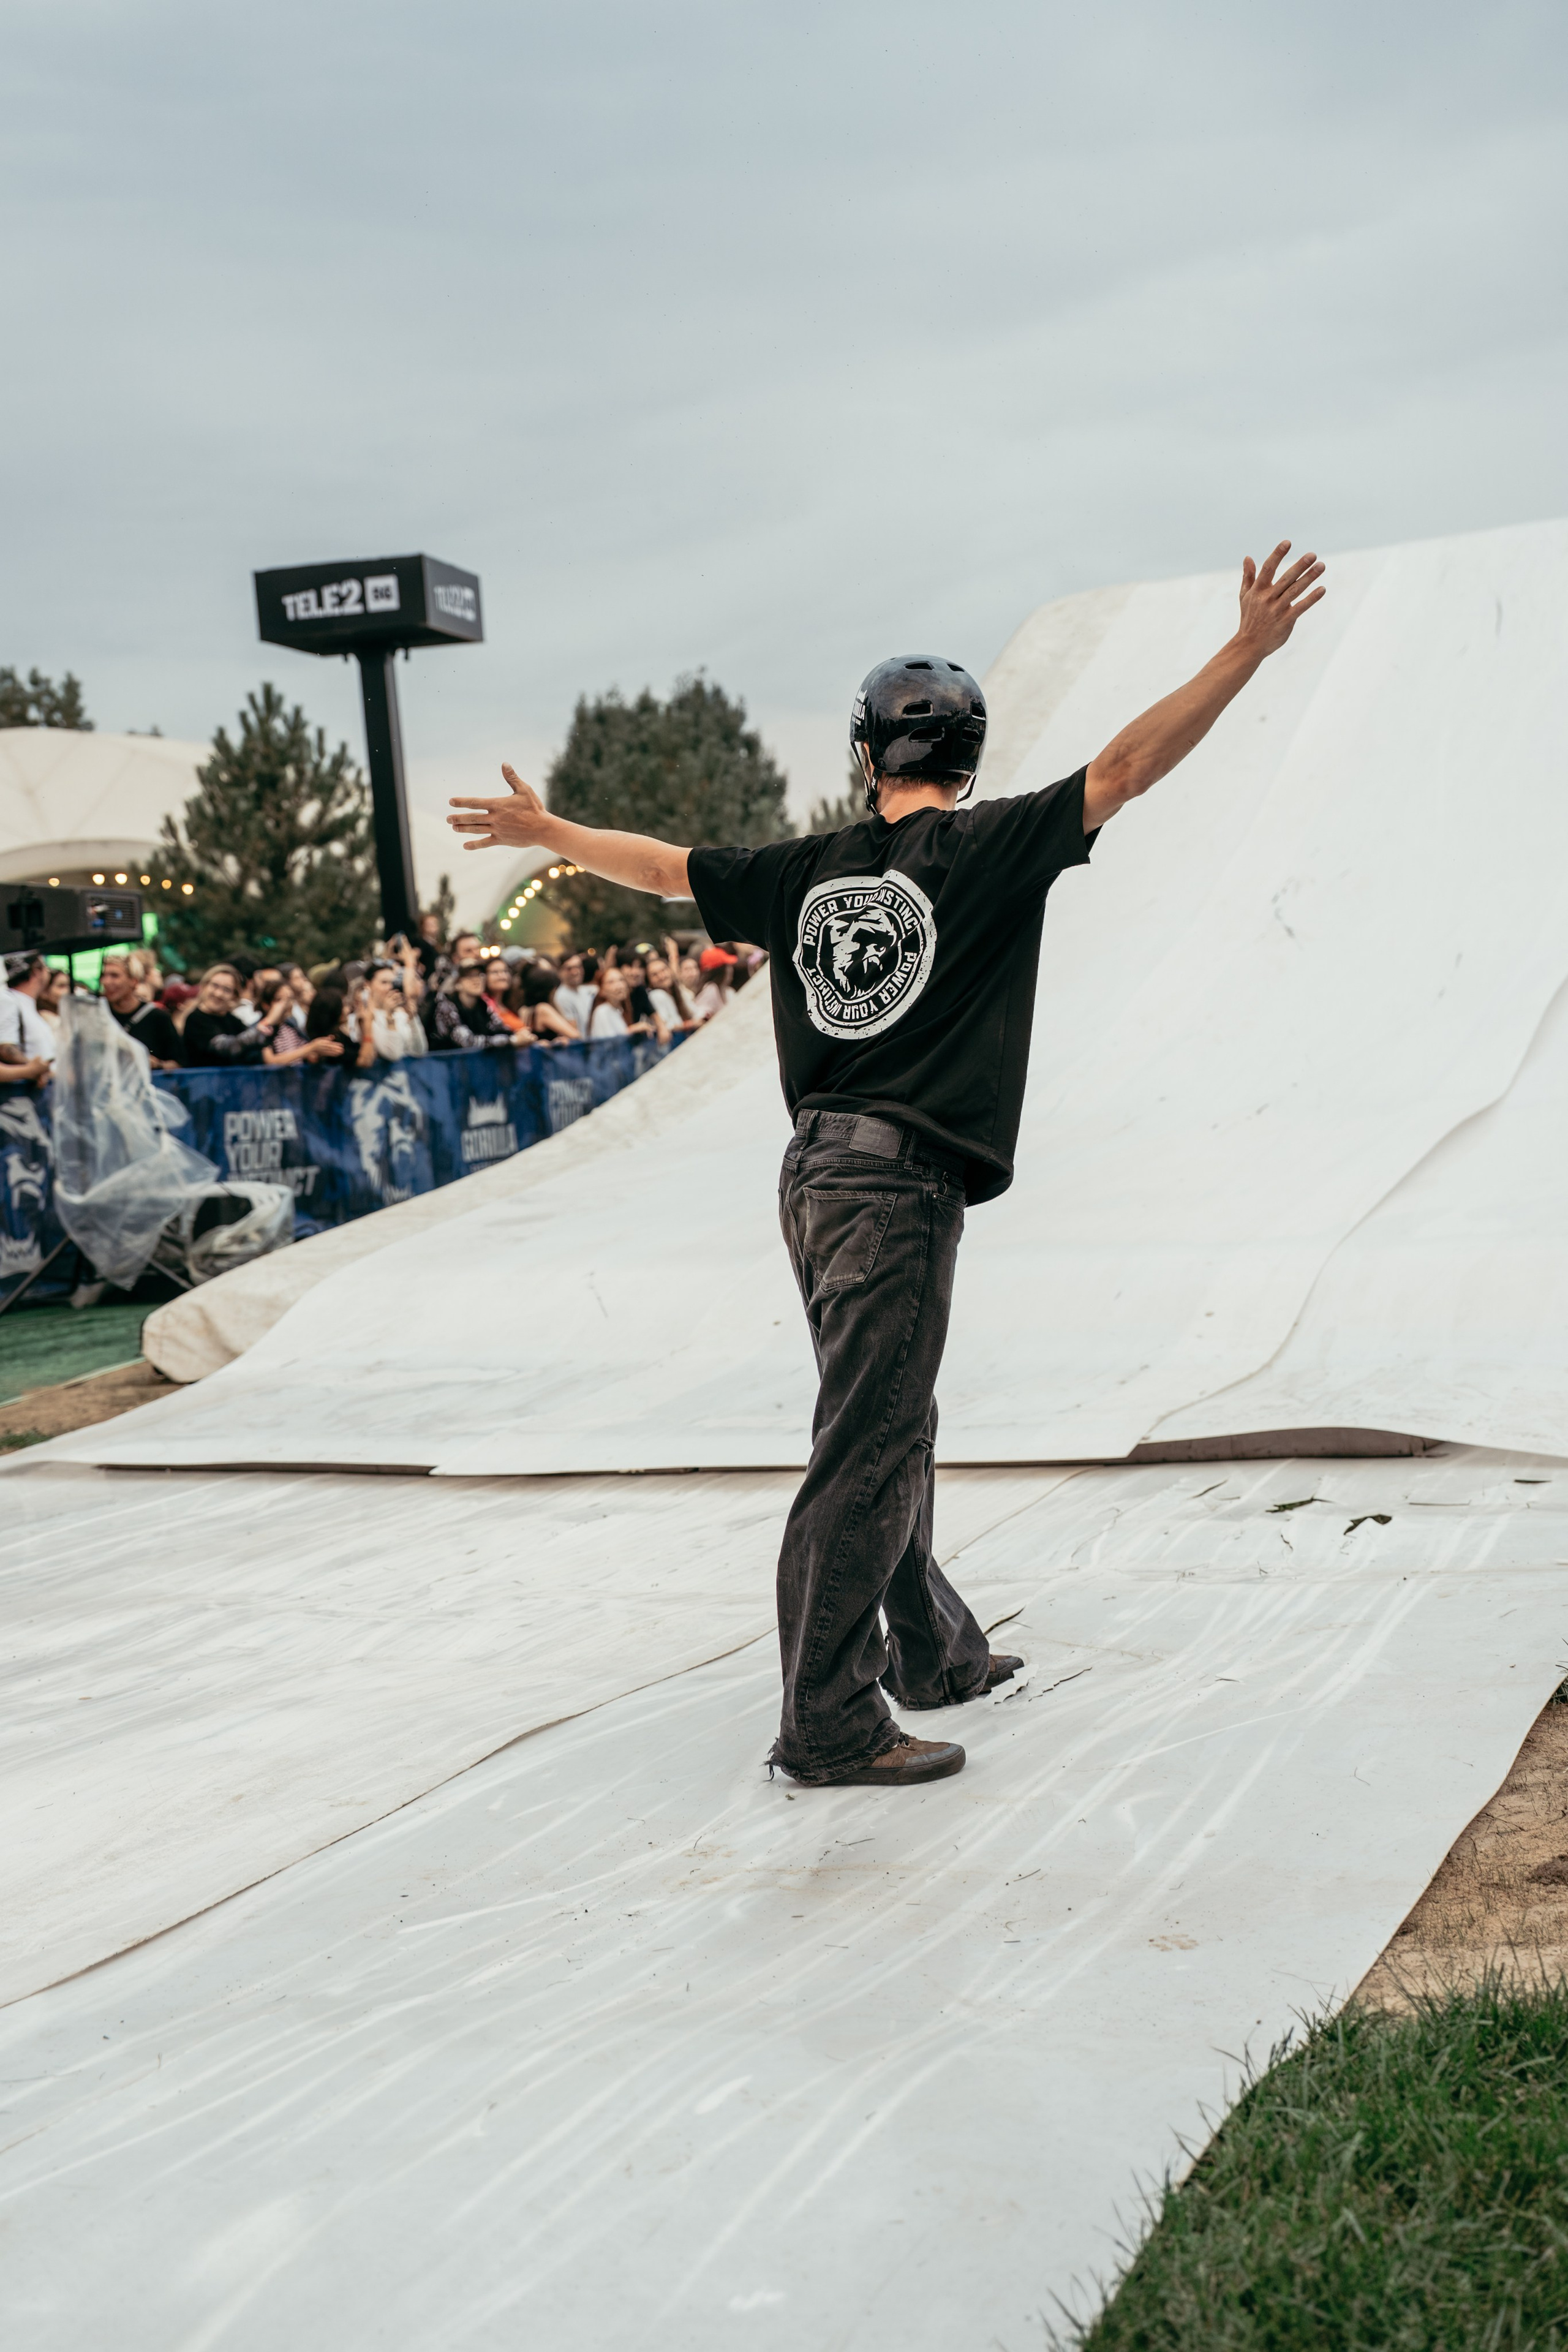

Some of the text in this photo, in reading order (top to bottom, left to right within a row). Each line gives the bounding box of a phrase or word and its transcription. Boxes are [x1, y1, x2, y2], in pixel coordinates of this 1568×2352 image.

[281, 578, 364, 622] TELE2
[803, 899, 839, 946] POWER
[876, 889, 918, 930] INSTINC
[806, 951, 918, 1020] POWER YOUR INSTINCT
[224, 1109, 298, 1144] POWER
